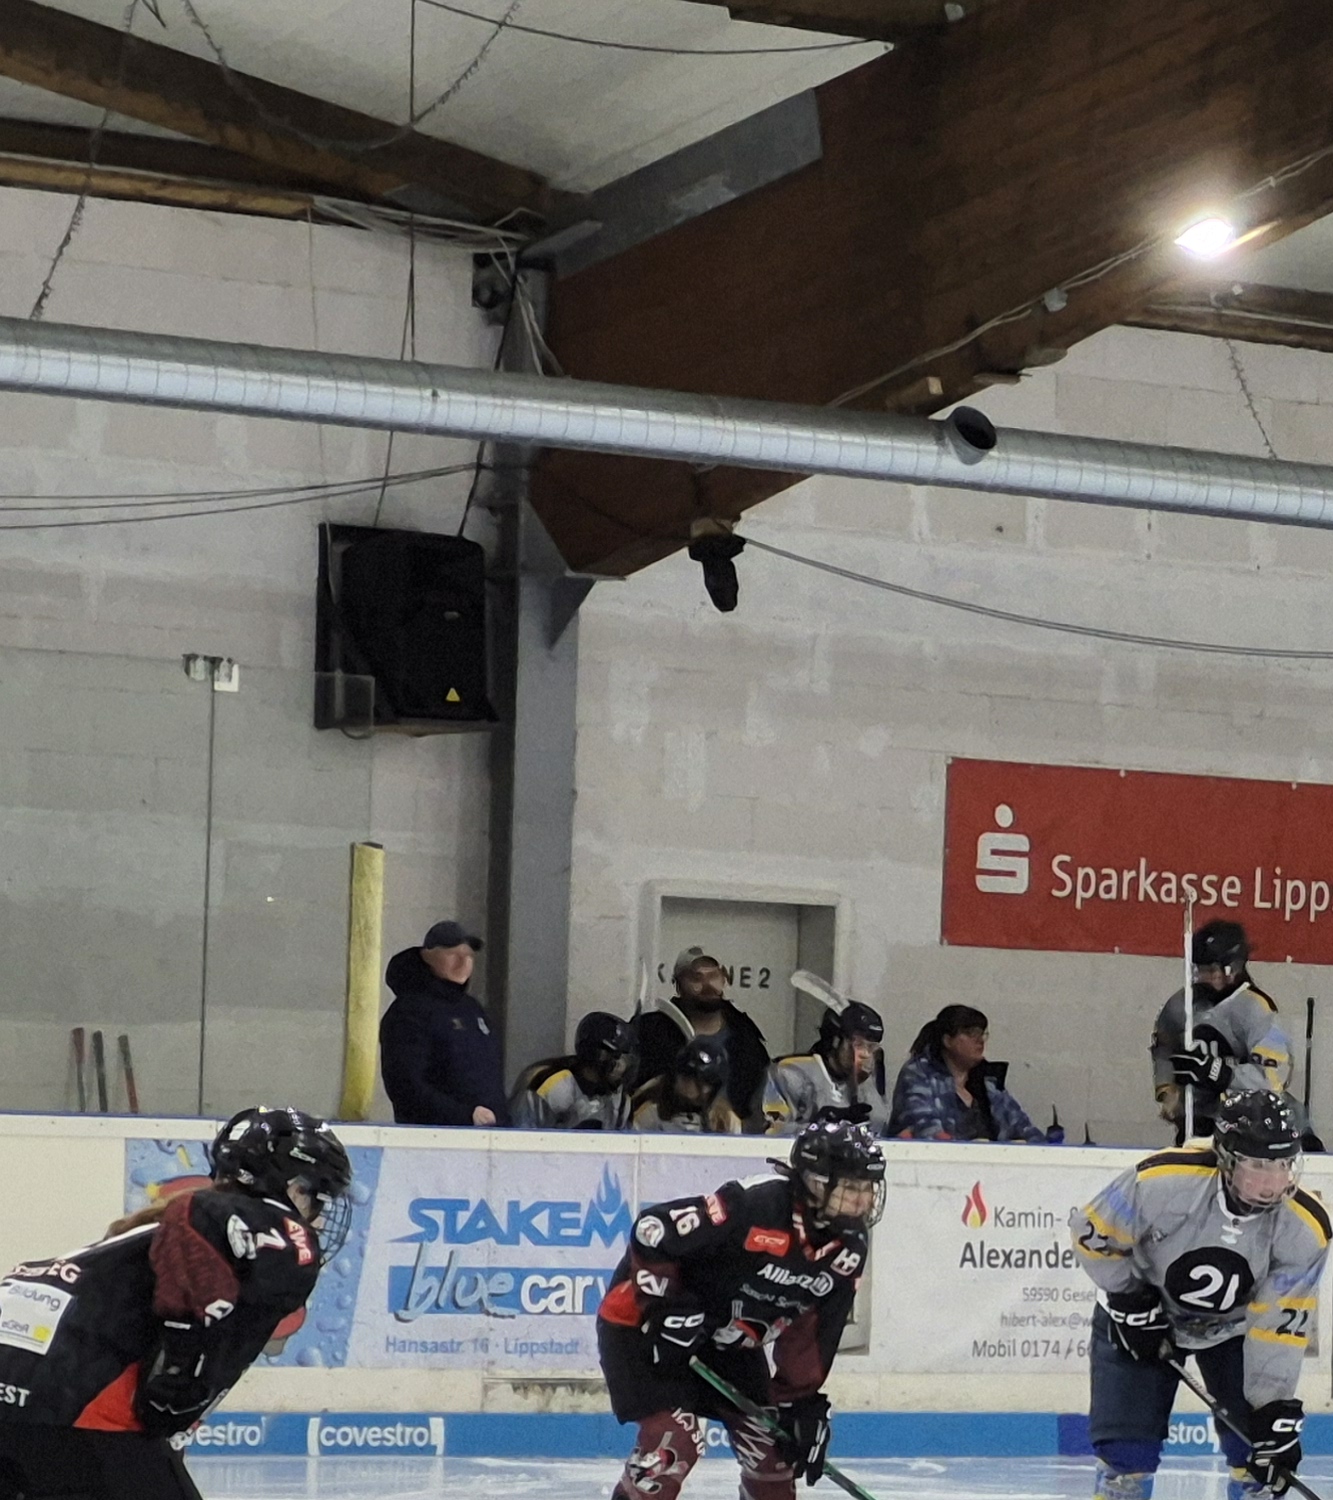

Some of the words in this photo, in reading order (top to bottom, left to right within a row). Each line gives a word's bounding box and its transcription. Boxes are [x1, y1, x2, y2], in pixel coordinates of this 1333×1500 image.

[1051, 853, 1242, 909] Sparkasse
[387, 1198, 640, 1248] STAKEM
[669, 1206, 700, 1237] 16
[993, 1206, 1063, 1229] Kamin-
[394, 1243, 521, 1323] blue
[1022, 1287, 1059, 1302] 59590
[1179, 1264, 1240, 1311] 21
[473, 1338, 490, 1354] 16
[504, 1336, 580, 1357] Lippstadt
[972, 1339, 1017, 1358] Mobil
[1021, 1340, 1060, 1358] 0174
[185, 1422, 261, 1447] vestro
[319, 1422, 429, 1447] covestro
